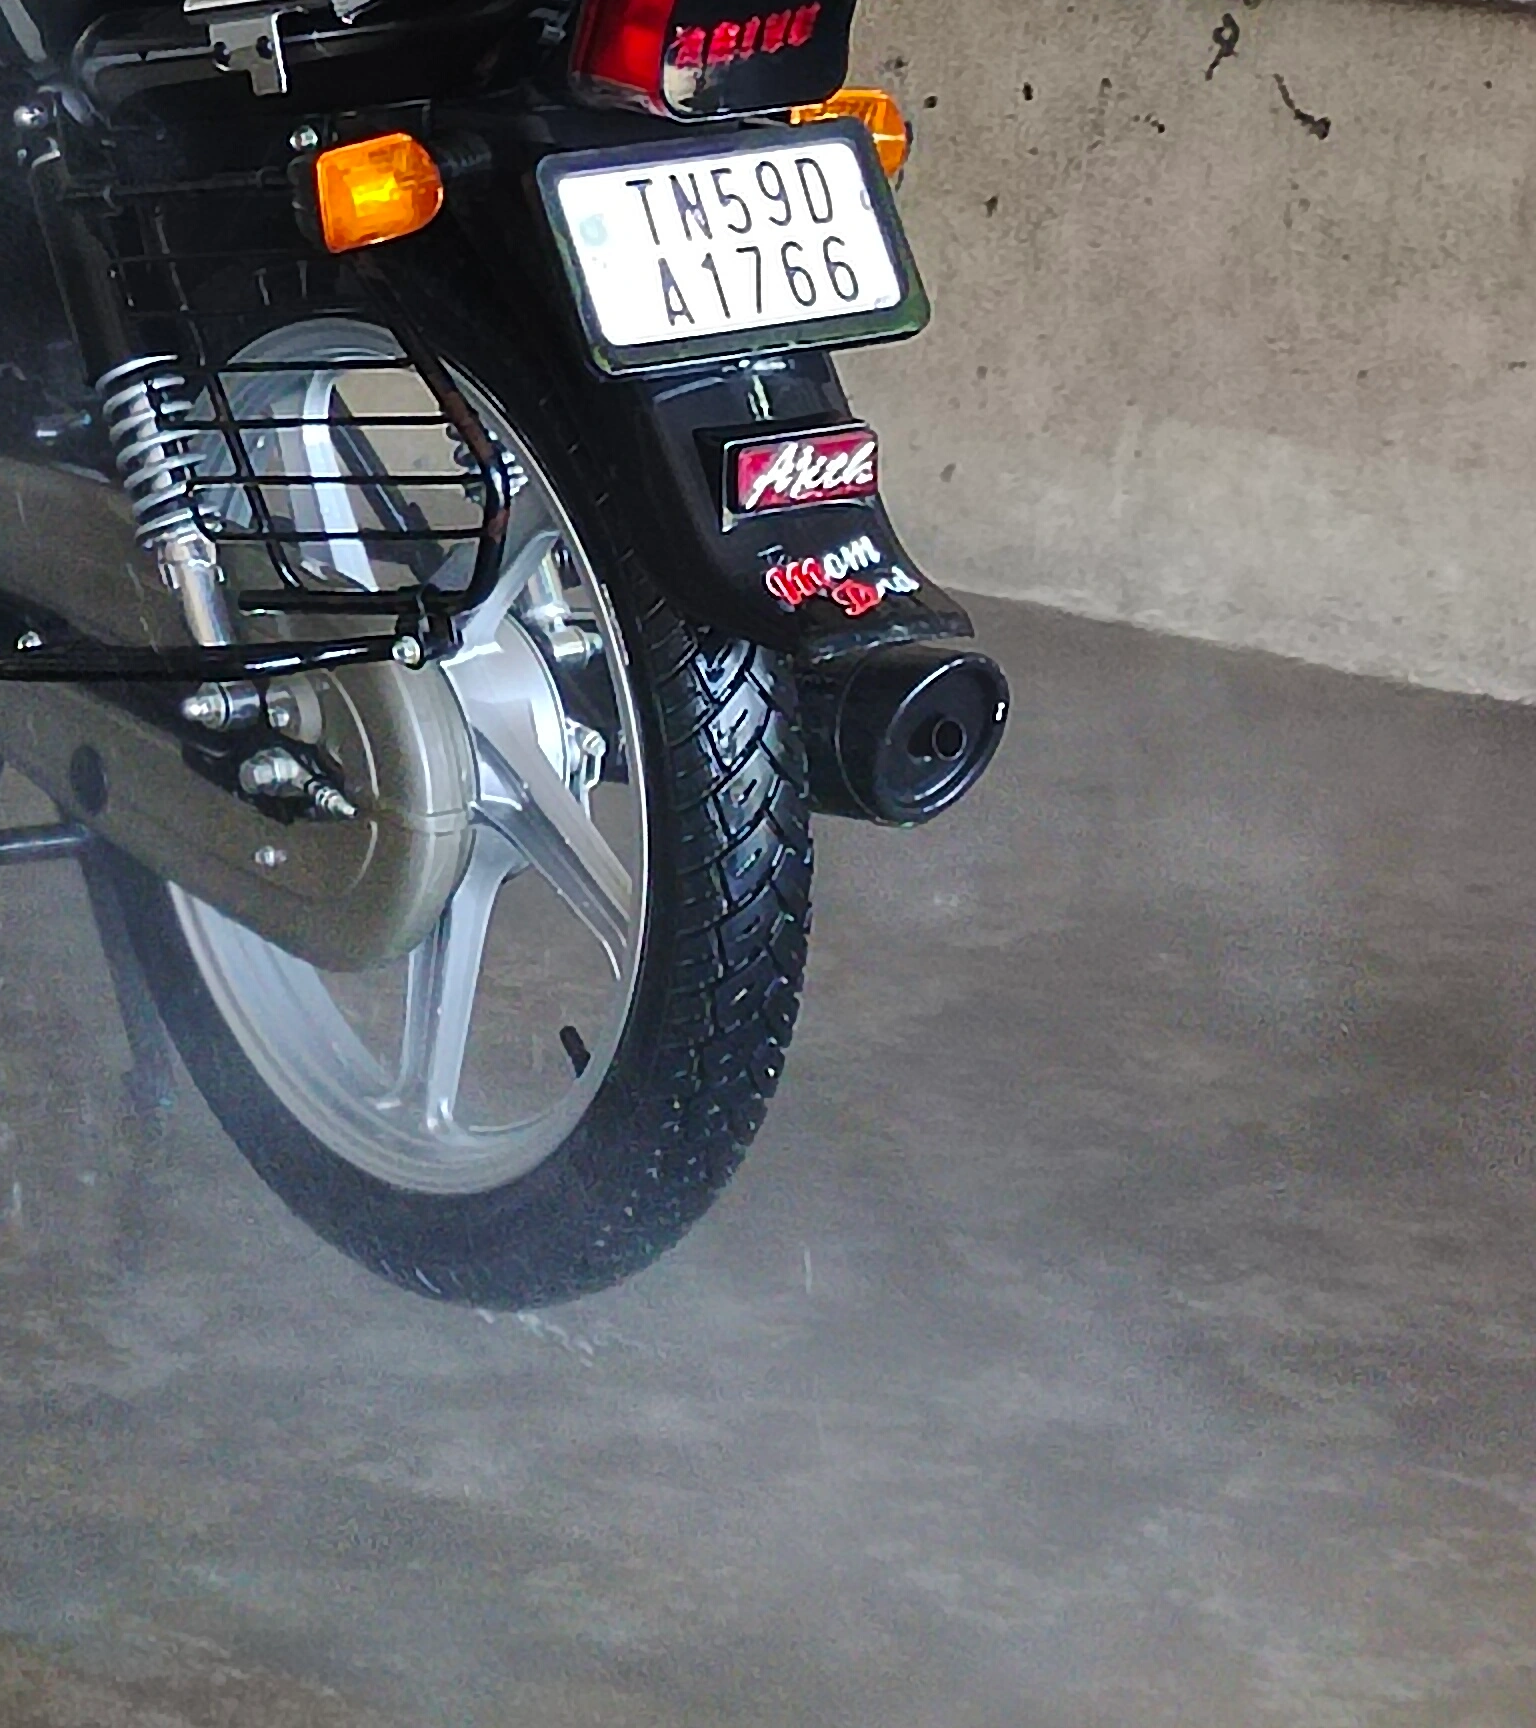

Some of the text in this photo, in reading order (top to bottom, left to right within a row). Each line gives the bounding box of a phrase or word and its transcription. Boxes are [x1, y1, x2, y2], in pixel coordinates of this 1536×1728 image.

[625, 157, 835, 245] TN59D
[657, 235, 860, 327] A1766
[765, 535, 882, 608] Mom
